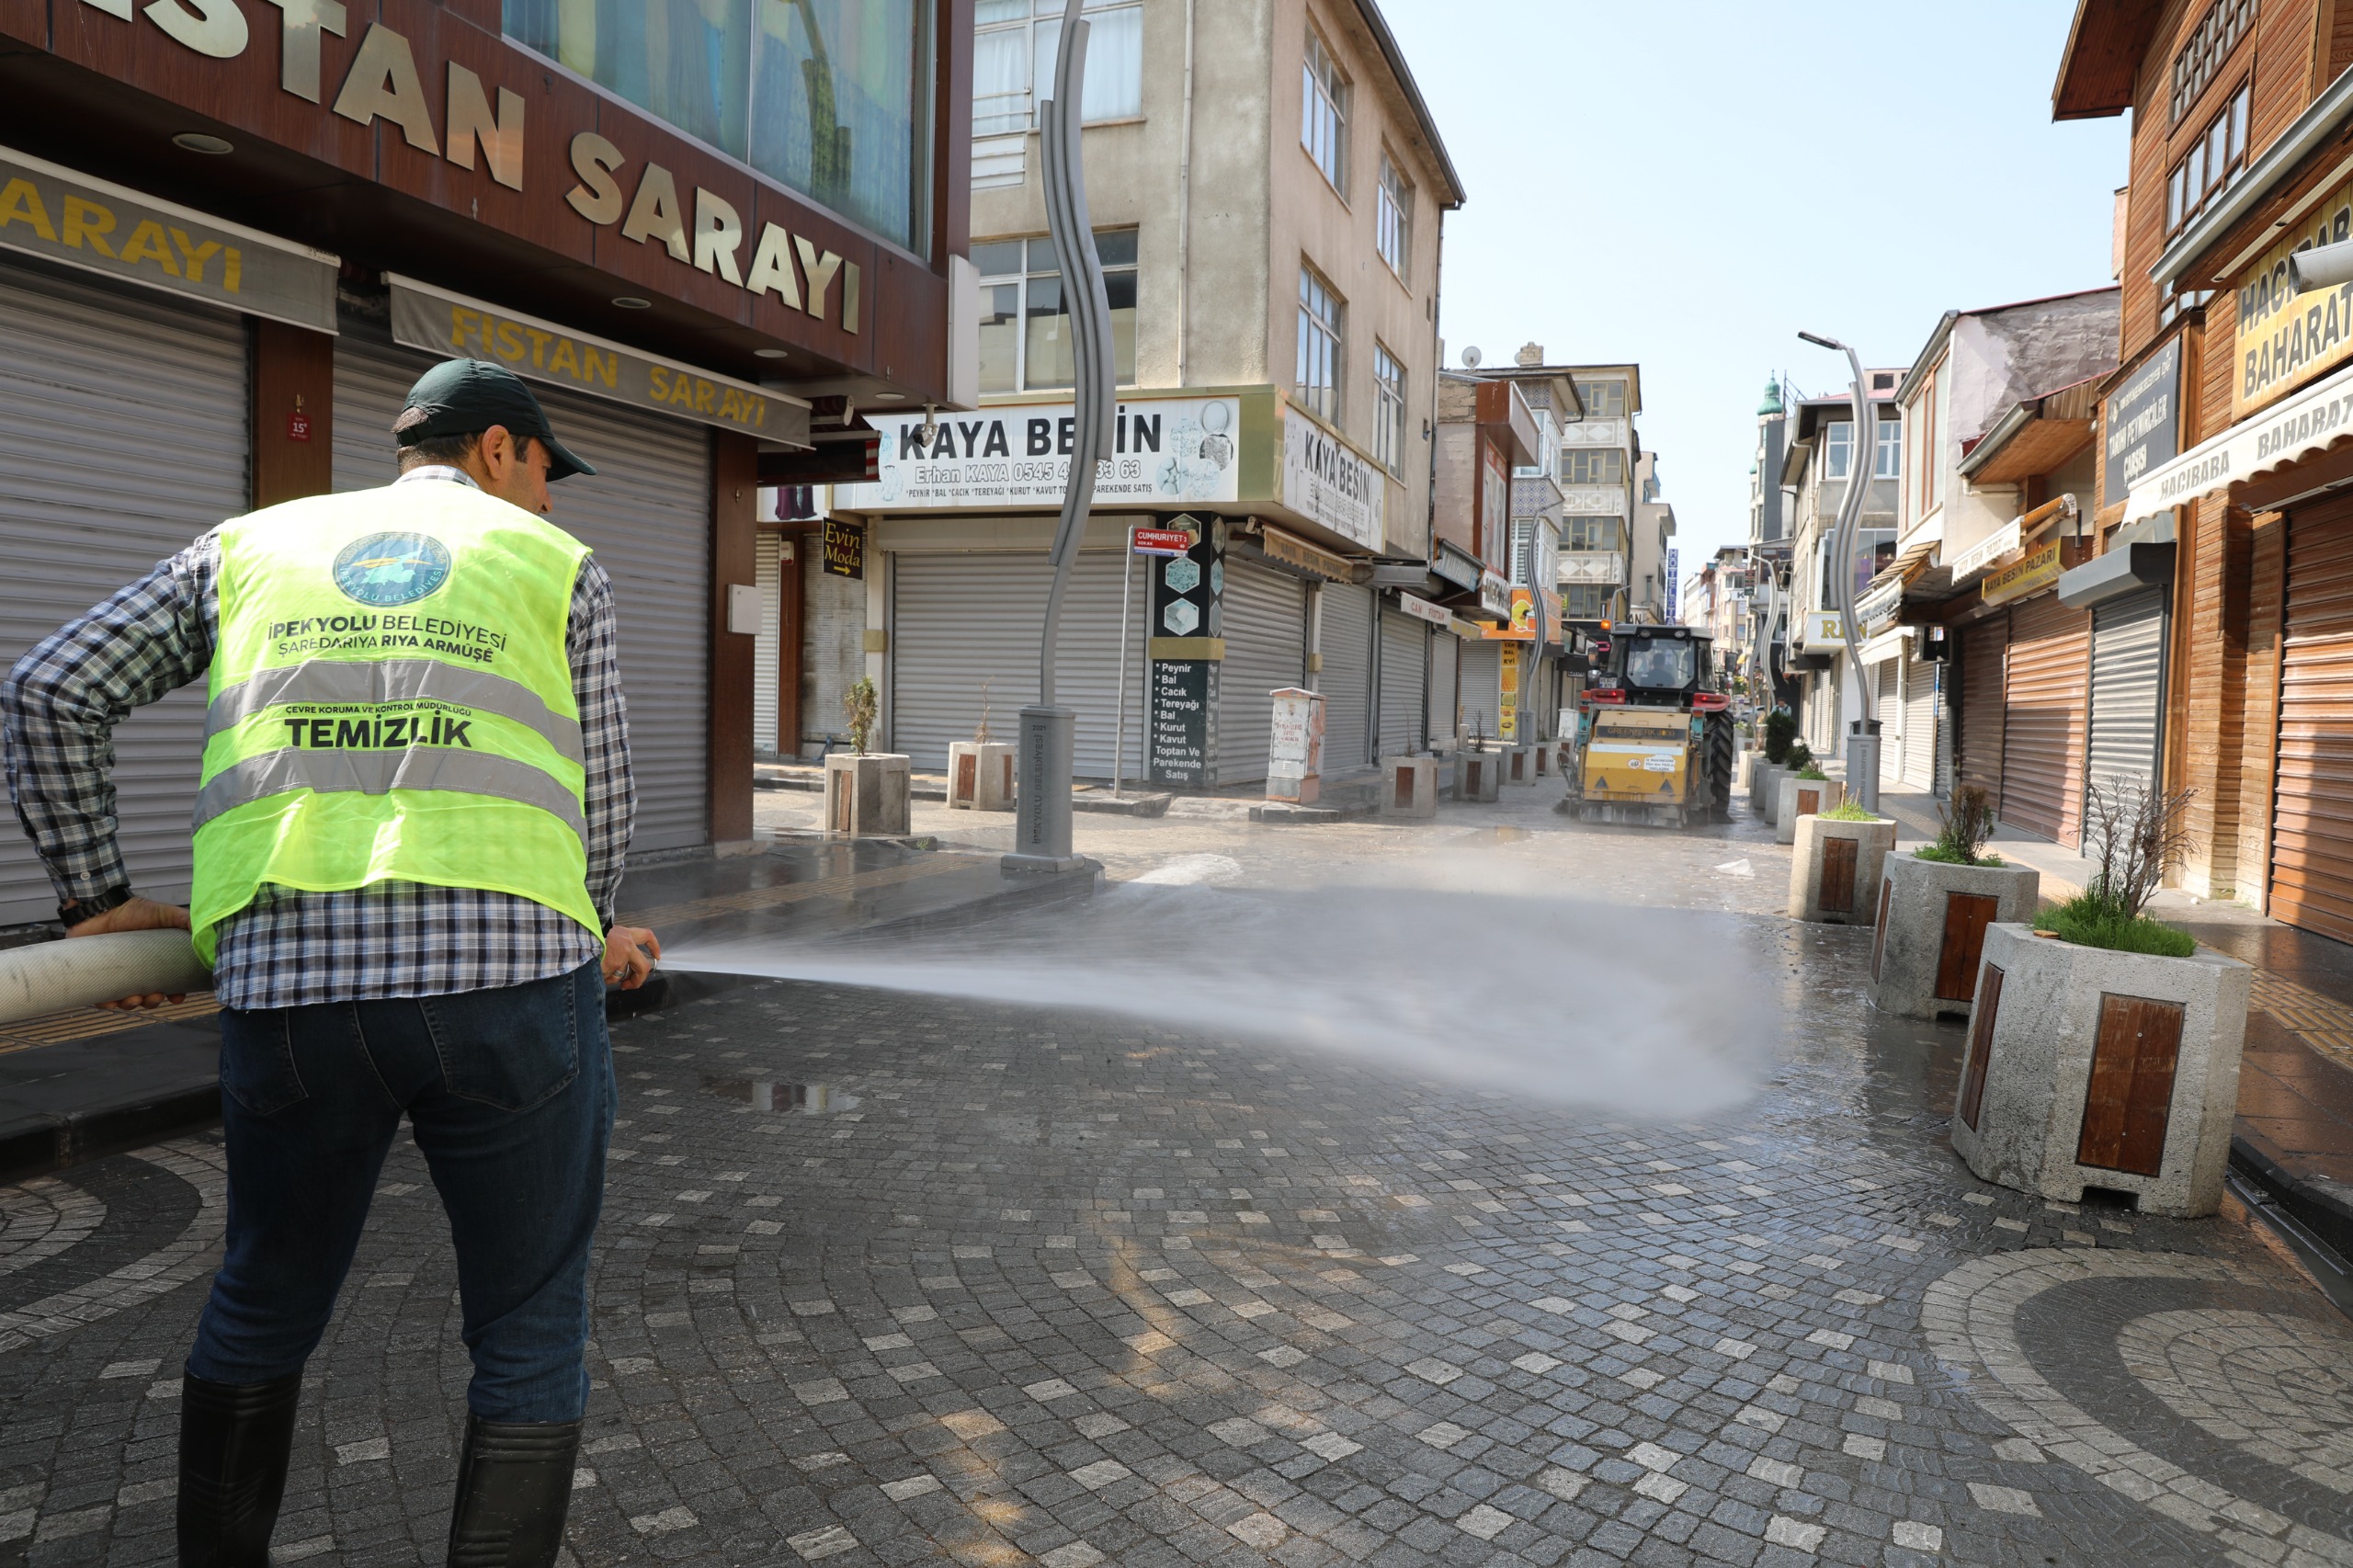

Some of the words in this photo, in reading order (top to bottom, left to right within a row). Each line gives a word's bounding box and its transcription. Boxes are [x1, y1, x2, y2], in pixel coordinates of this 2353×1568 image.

[564, 131, 859, 335] SARAYI
[450, 305, 618, 389] FISTAN
[649, 366, 766, 427] SARAYI
[900, 420, 1010, 460] KAYA
[1027, 405, 1161, 457] BEİN
[915, 466, 961, 483] Erhan
[965, 464, 1009, 482] KAYA
[1013, 462, 1054, 481] 0545
[1120, 460, 1141, 478] 63
[1304, 430, 1336, 488] KAYA
[1339, 457, 1370, 506] BESİN
[2160, 449, 2230, 502] HACIBABA
[908, 487, 930, 497] PEYNİR
[935, 489, 946, 497] BAL
[951, 488, 970, 496] CACIK
[974, 485, 1005, 496] TEREYAĞI
[1010, 487, 1030, 495] KURUT
[1036, 486, 1057, 494] KAVUT
[1133, 483, 1152, 494] SATIŞ
[825, 522, 860, 550] Evin
[1138, 532, 1183, 542] CUMHURİYET
[824, 545, 860, 567] Moda
[1985, 576, 2000, 592] KAYA
[2003, 563, 2024, 585] BESİN
[2026, 547, 2055, 574] PAZARI
[384, 567, 443, 602] BELEDİYESİ
[268, 615, 377, 641] İPEKYOLU
[382, 615, 507, 652] BELEDİYESİ
[278, 636, 378, 657] ŞAREDARIYA
[381, 634, 419, 647] RIYA
[424, 637, 494, 663] ARMÛŞÊ
[1162, 663, 1191, 674] Peynir
[1162, 675, 1176, 684] Bal
[1162, 687, 1187, 697] Cacık
[286, 706, 316, 715] ÇEVRE
[319, 706, 359, 714] KORUMA
[376, 703, 414, 713] KONTROL
[416, 701, 472, 717] MÜDÜRLÜĞÜ
[1160, 710, 1176, 720] Bal
[1161, 699, 1199, 710] Tereyağı
[285, 710, 472, 748] TEMİZLİK
[1160, 722, 1186, 732] Kurut
[1159, 734, 1186, 744] Kavut
[1155, 745, 1186, 756] Toptan
[1188, 747, 1199, 756] Ve
[1034, 734, 1043, 790] BELEDİYESİ
[1154, 757, 1201, 768] Parekende
[1165, 770, 1188, 781] Satış
[1031, 795, 1042, 845] İPEKYOLU
